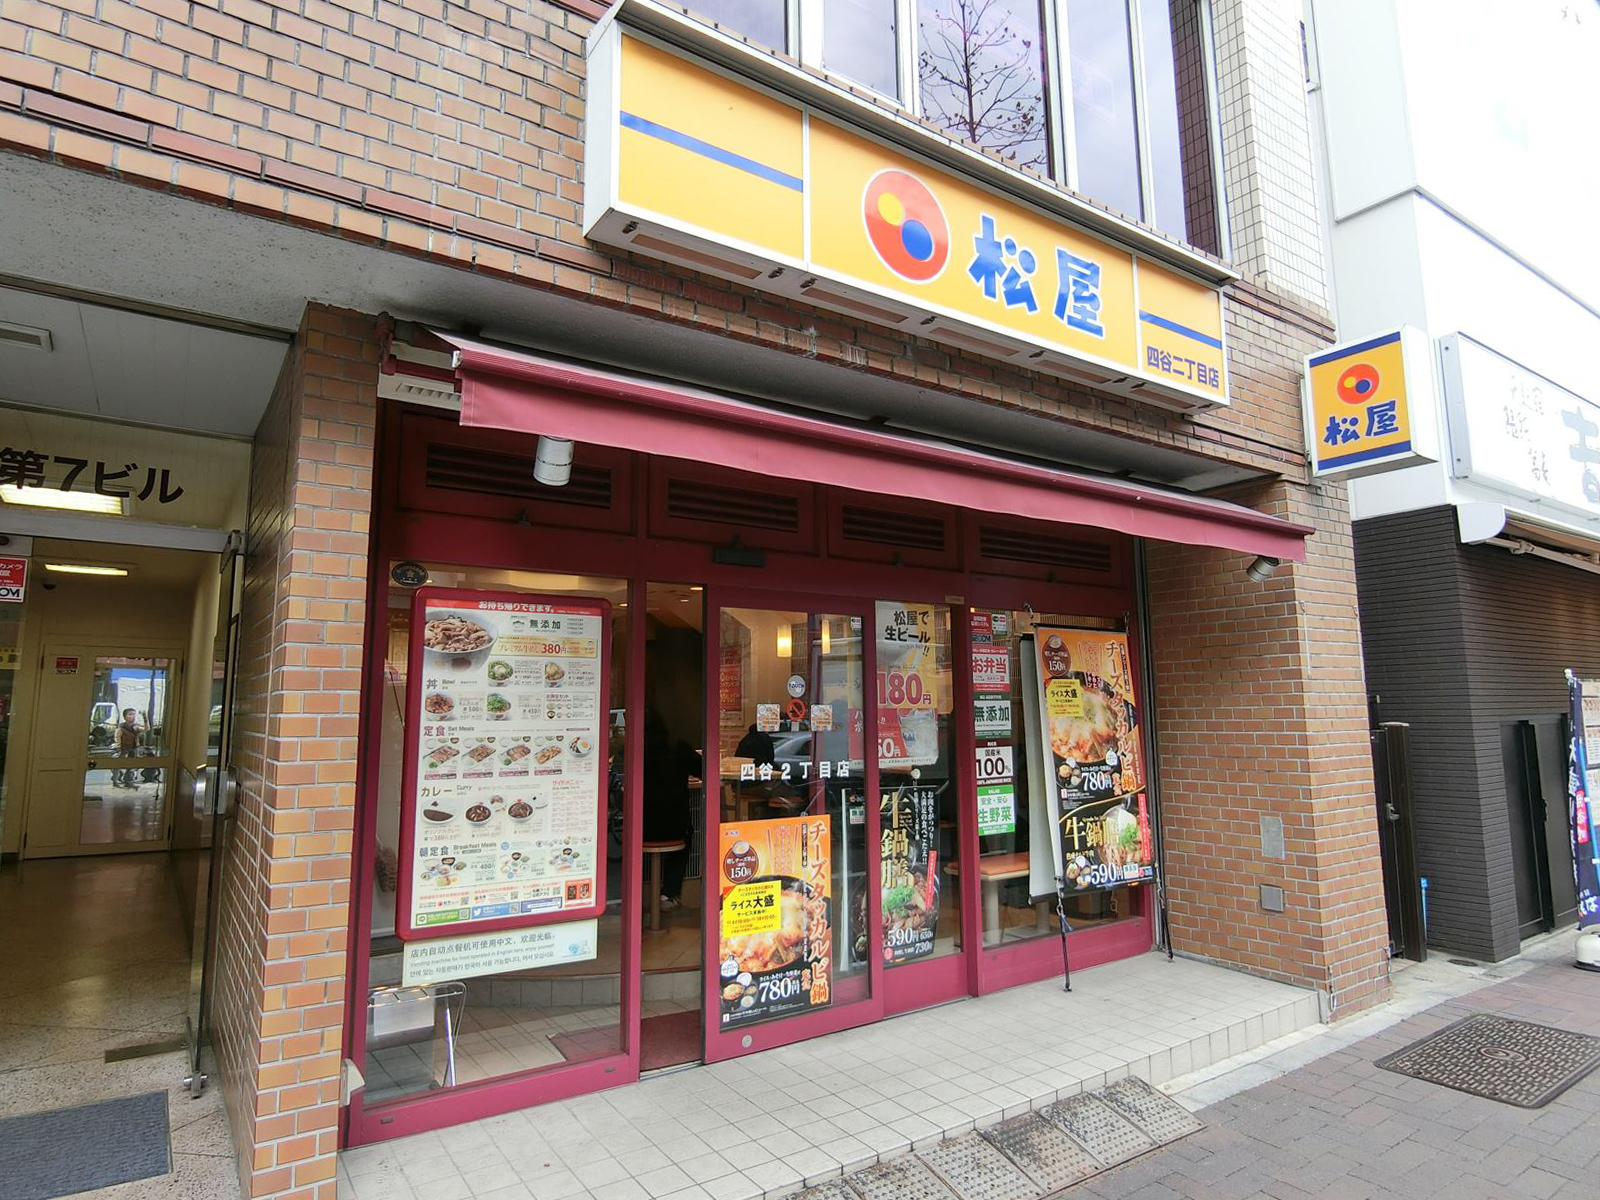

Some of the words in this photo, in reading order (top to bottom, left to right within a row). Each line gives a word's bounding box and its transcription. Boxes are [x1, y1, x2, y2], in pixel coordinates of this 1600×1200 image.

[966, 211, 1106, 340] 松屋
[1146, 344, 1220, 390] 四谷二丁目店
[1322, 400, 1399, 446] 松屋
[0, 447, 185, 504] 第7ビル
[478, 601, 555, 614] お持ち帰りできます。
[529, 619, 561, 630] 無添加
[894, 610, 930, 626] 松屋で
[885, 625, 931, 644] 生ビール
[973, 656, 1007, 674] お弁当
[426, 679, 438, 690] 丼
[974, 705, 1010, 722] 無添加
[424, 725, 446, 737] 定食
[740, 760, 850, 781] 四谷2丁目店
[1081, 770, 1112, 792] 780円
[421, 786, 453, 797] カレー
[978, 806, 1012, 824] 生野菜
[419, 845, 449, 857] 朝定食
[1090, 861, 1124, 885] 590円
[731, 894, 775, 911] ライス大盛
[809, 820, 830, 1005] チーズタッカルビ鍋
[759, 977, 800, 1004] 780円
